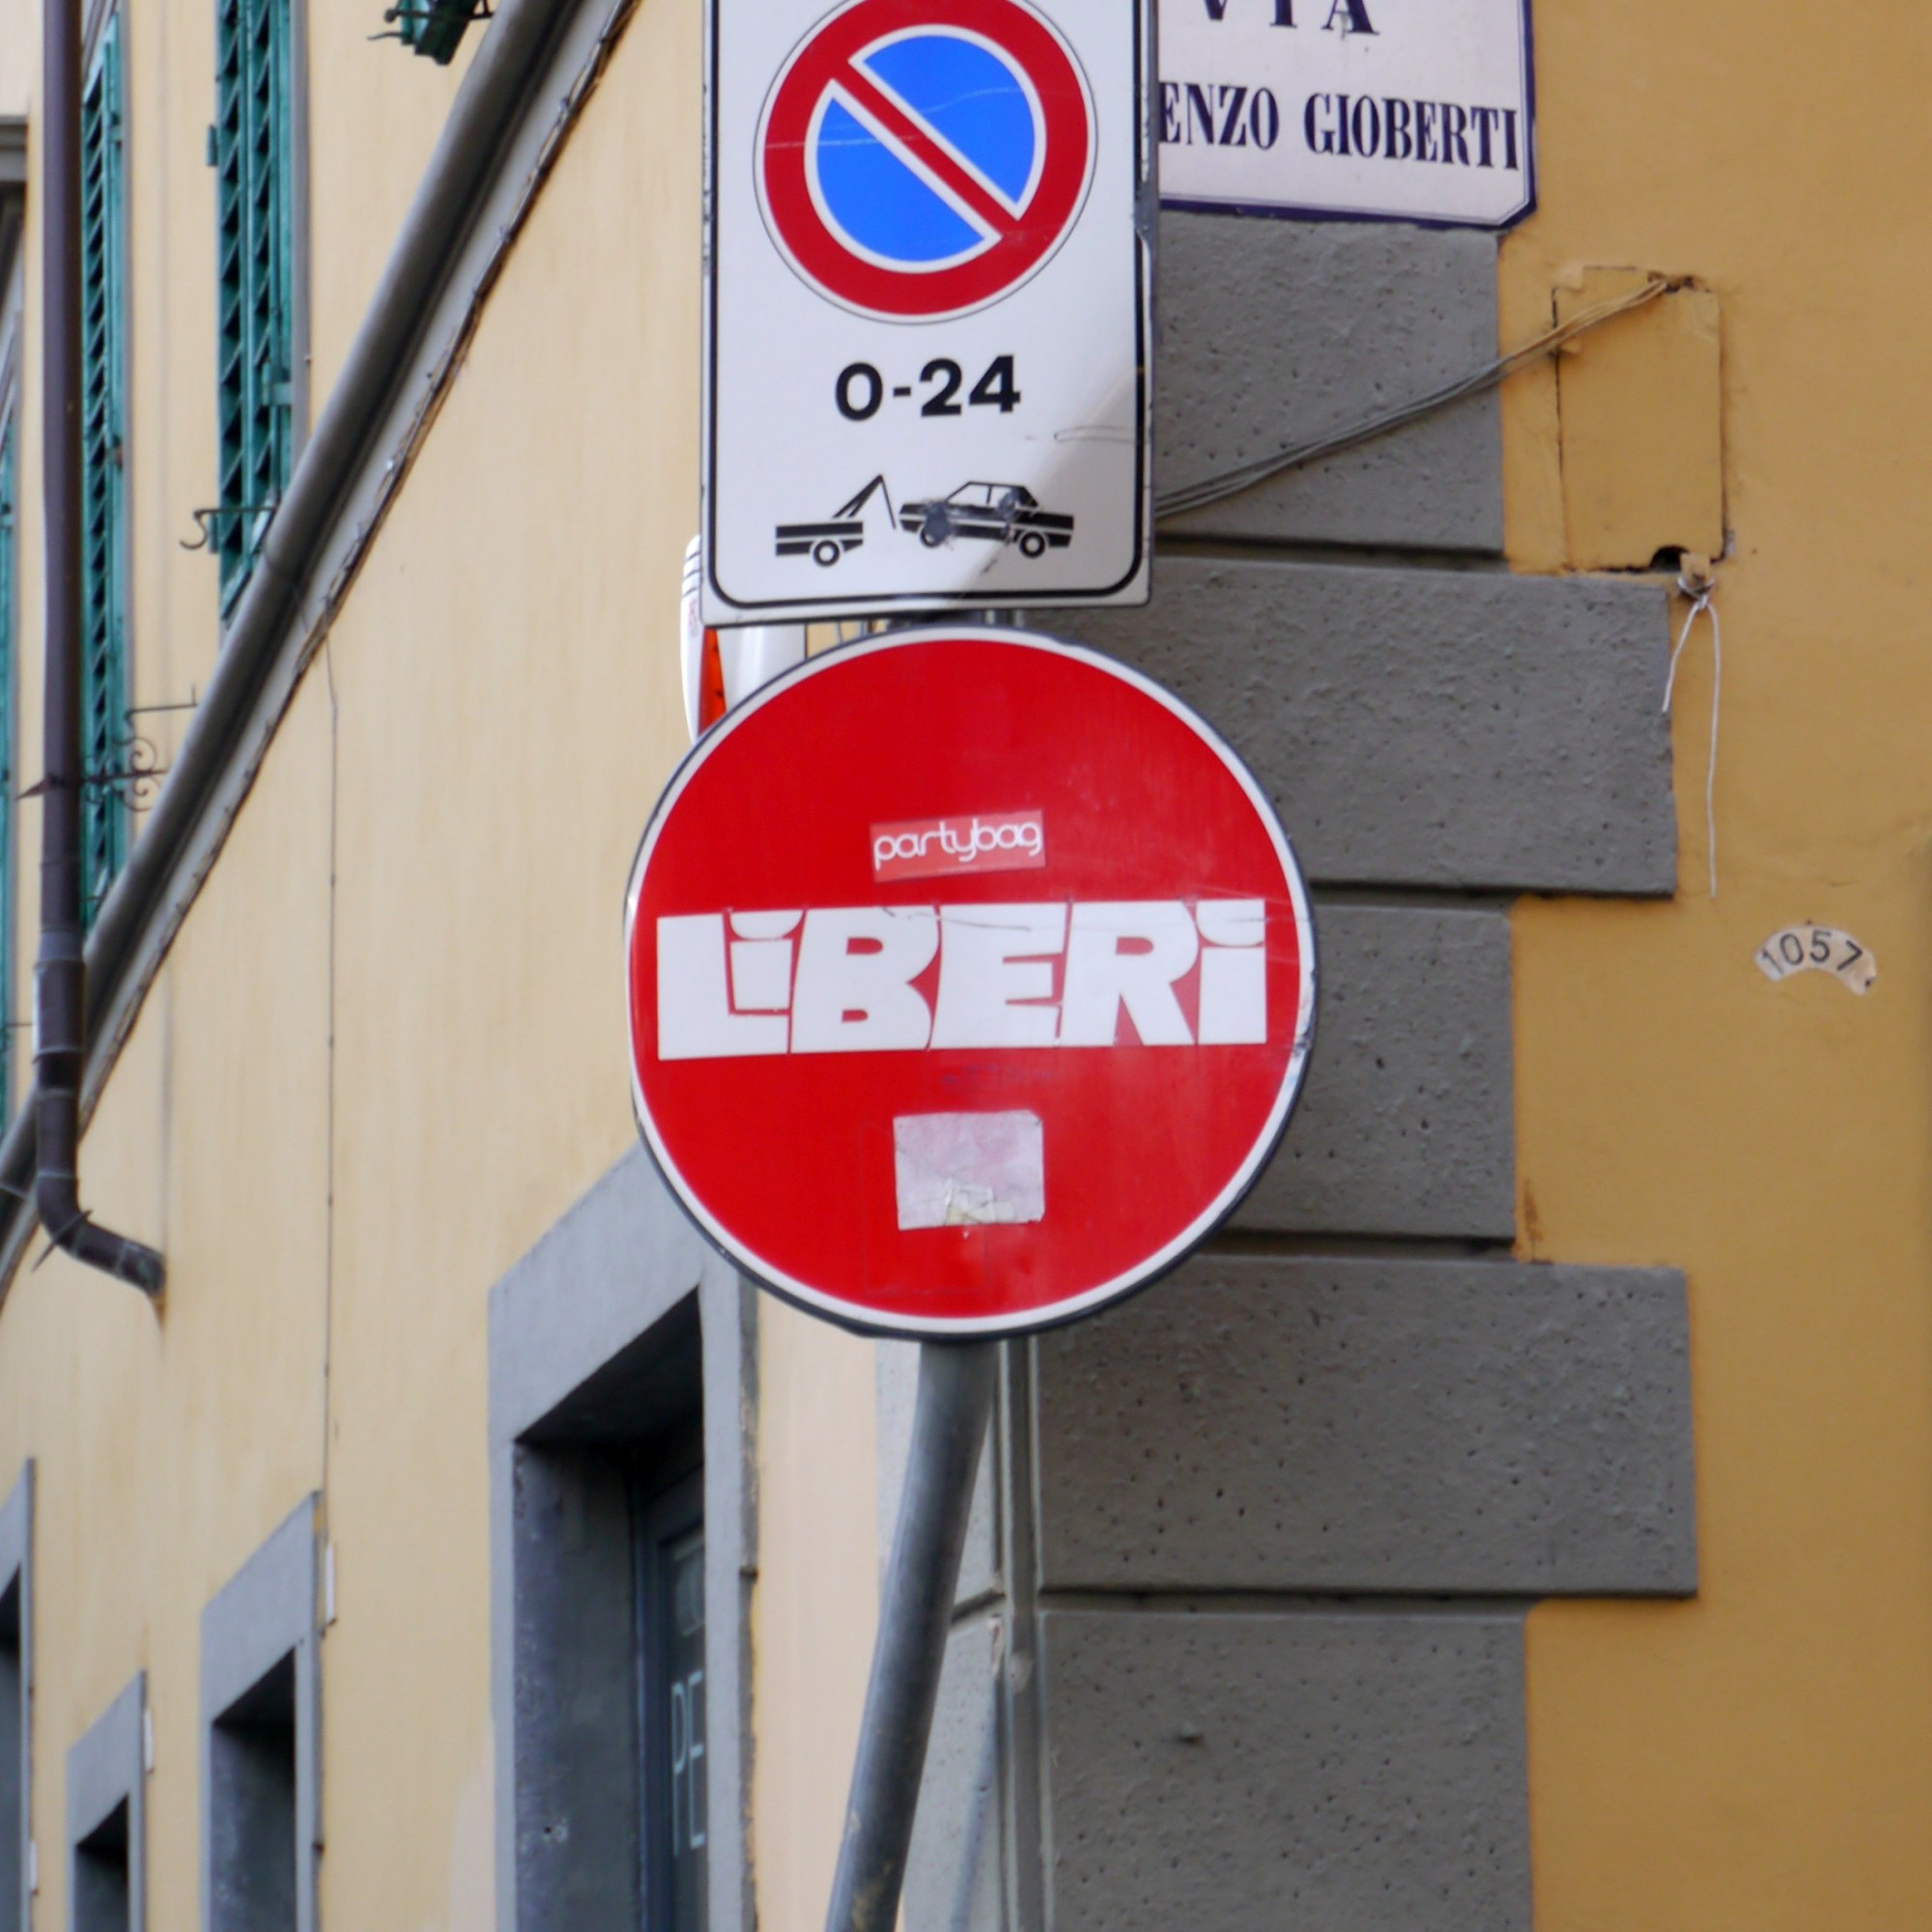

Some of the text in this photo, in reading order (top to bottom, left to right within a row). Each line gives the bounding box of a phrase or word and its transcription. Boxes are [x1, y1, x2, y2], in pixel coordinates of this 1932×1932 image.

[1303, 92, 1520, 171] GIOBERTI
[835, 354, 1021, 421] 0-24
[873, 817, 1043, 871] partybag
[1760, 929, 1863, 976] 1057
